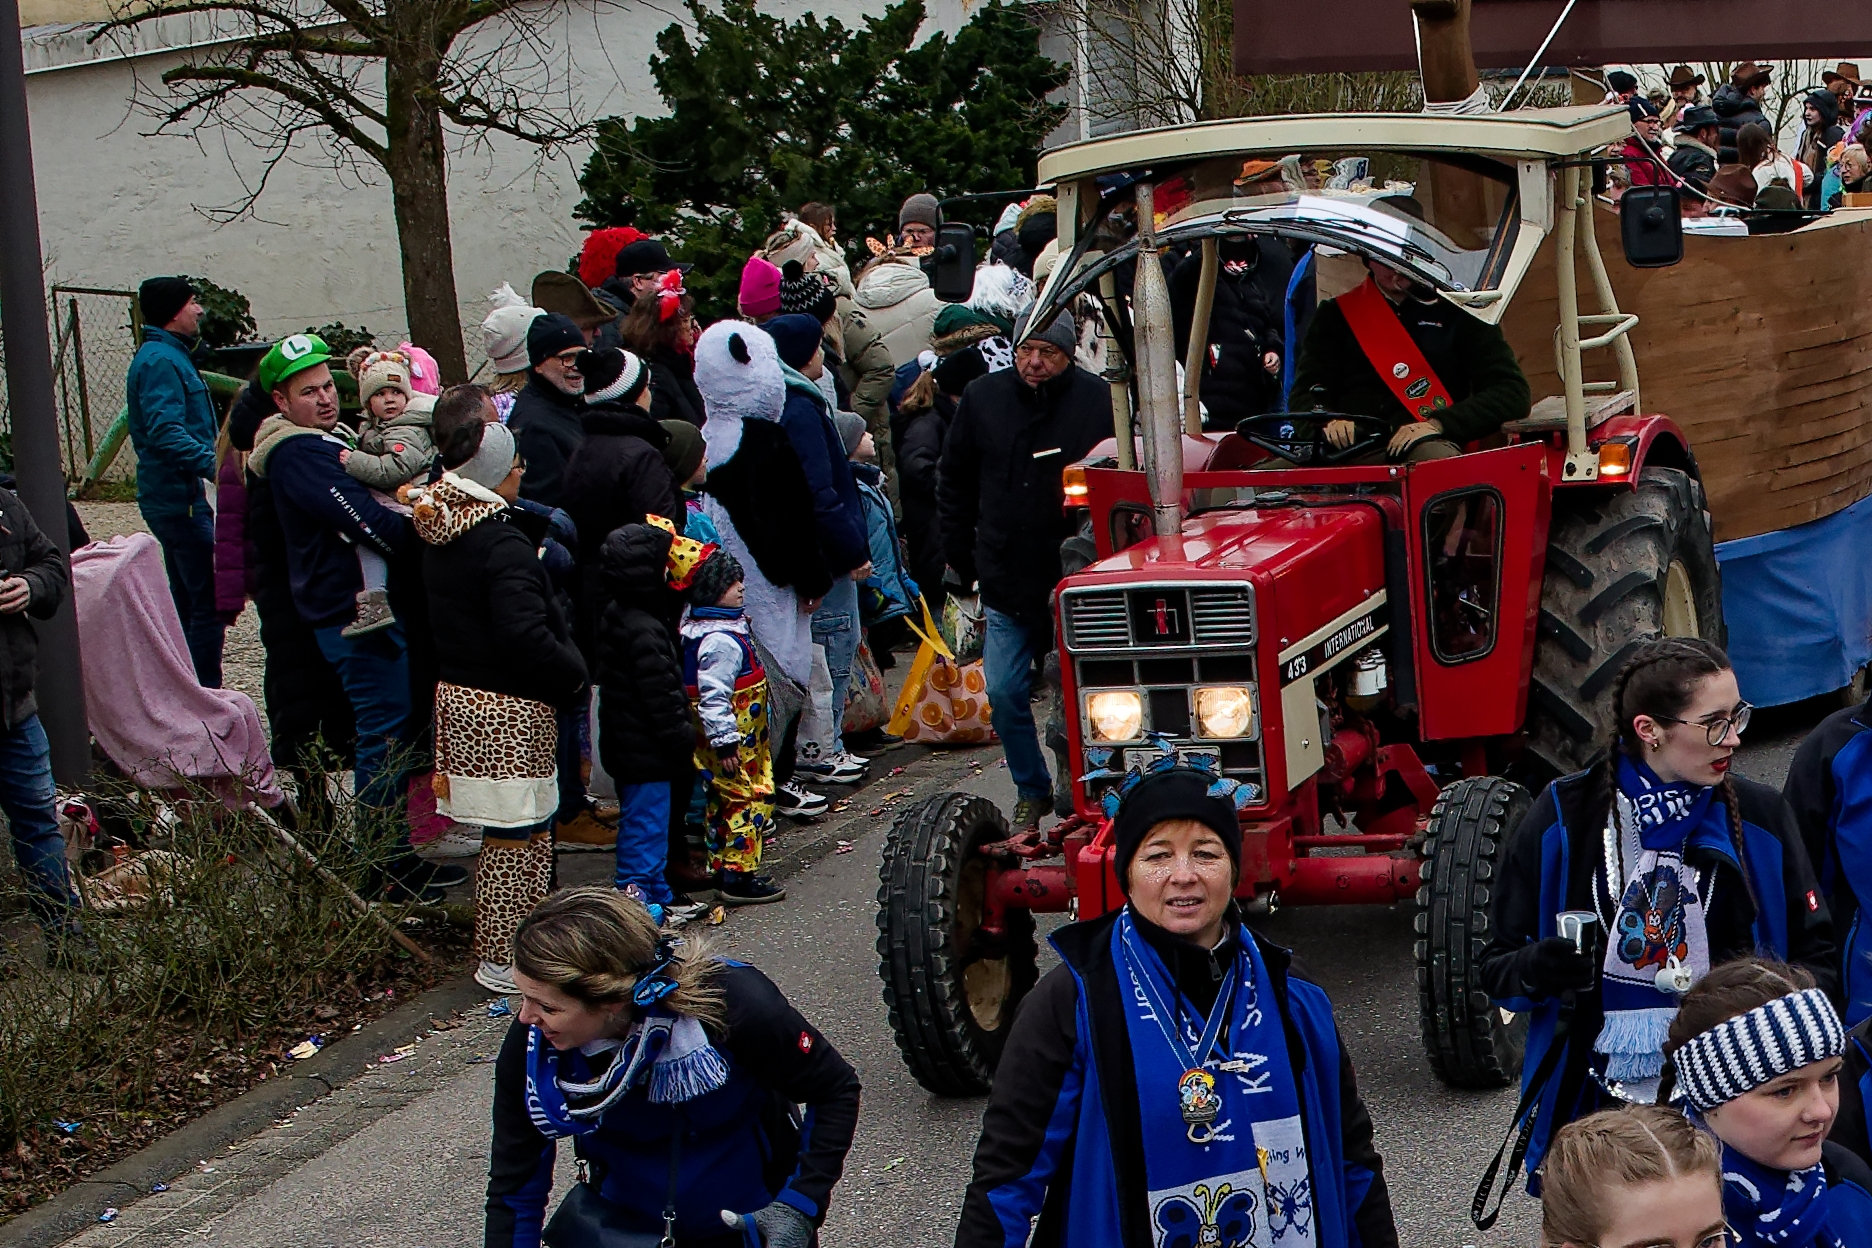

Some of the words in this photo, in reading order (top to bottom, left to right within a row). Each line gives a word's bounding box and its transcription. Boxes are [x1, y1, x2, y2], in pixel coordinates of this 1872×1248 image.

[287, 340, 306, 355] L
[329, 486, 362, 522] HILFIGER
[1324, 615, 1375, 659] INTERNATIONAL
[1287, 655, 1307, 680] 433
